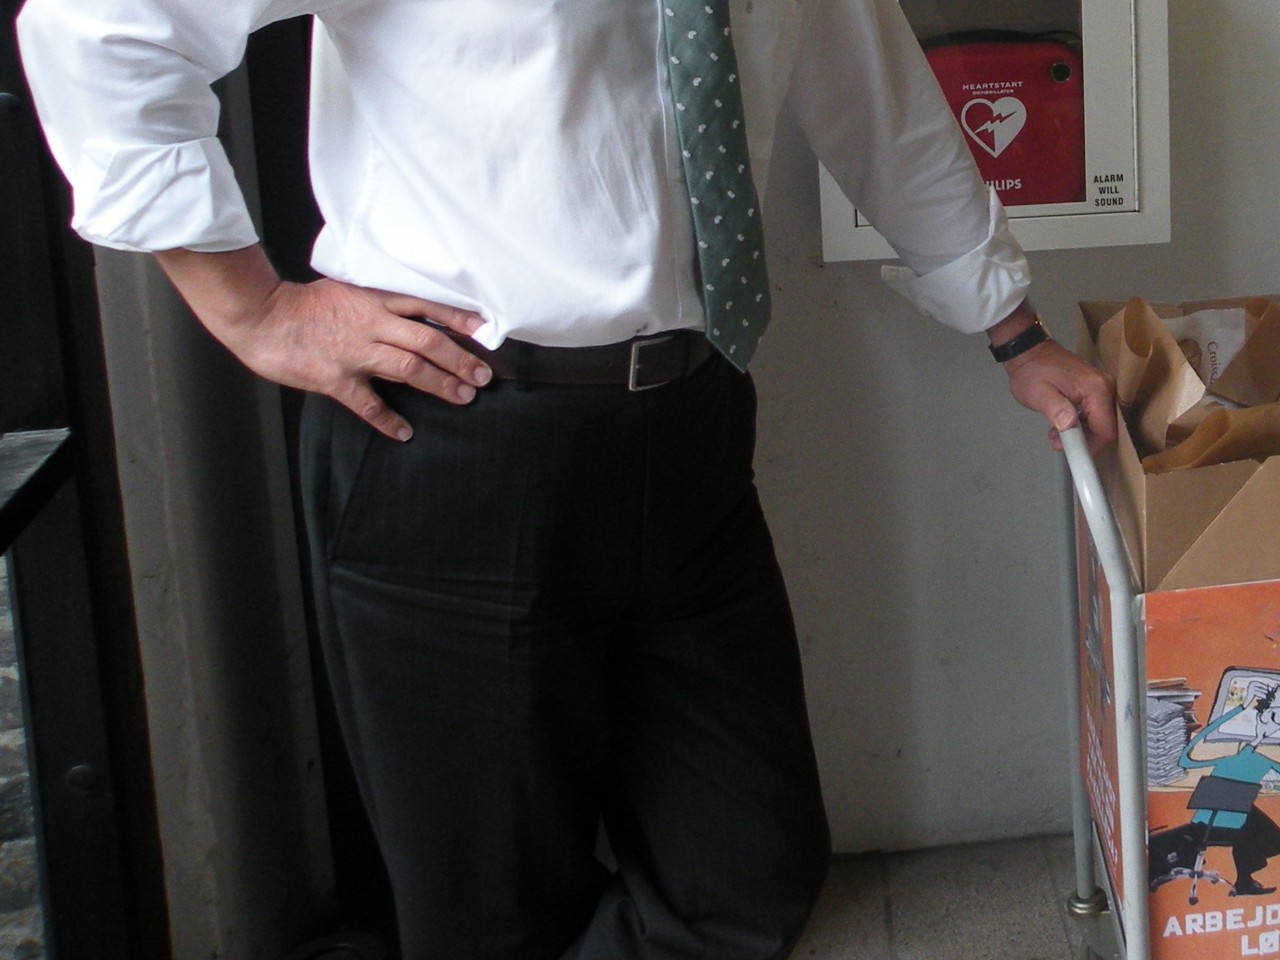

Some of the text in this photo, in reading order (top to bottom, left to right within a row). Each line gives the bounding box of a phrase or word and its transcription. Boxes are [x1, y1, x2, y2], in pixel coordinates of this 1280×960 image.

[962, 81, 1024, 91] HEARTSTART
[1093, 173, 1124, 184] ALARM
[1098, 186, 1119, 195] WILL
[1094, 197, 1124, 207] SOUND
